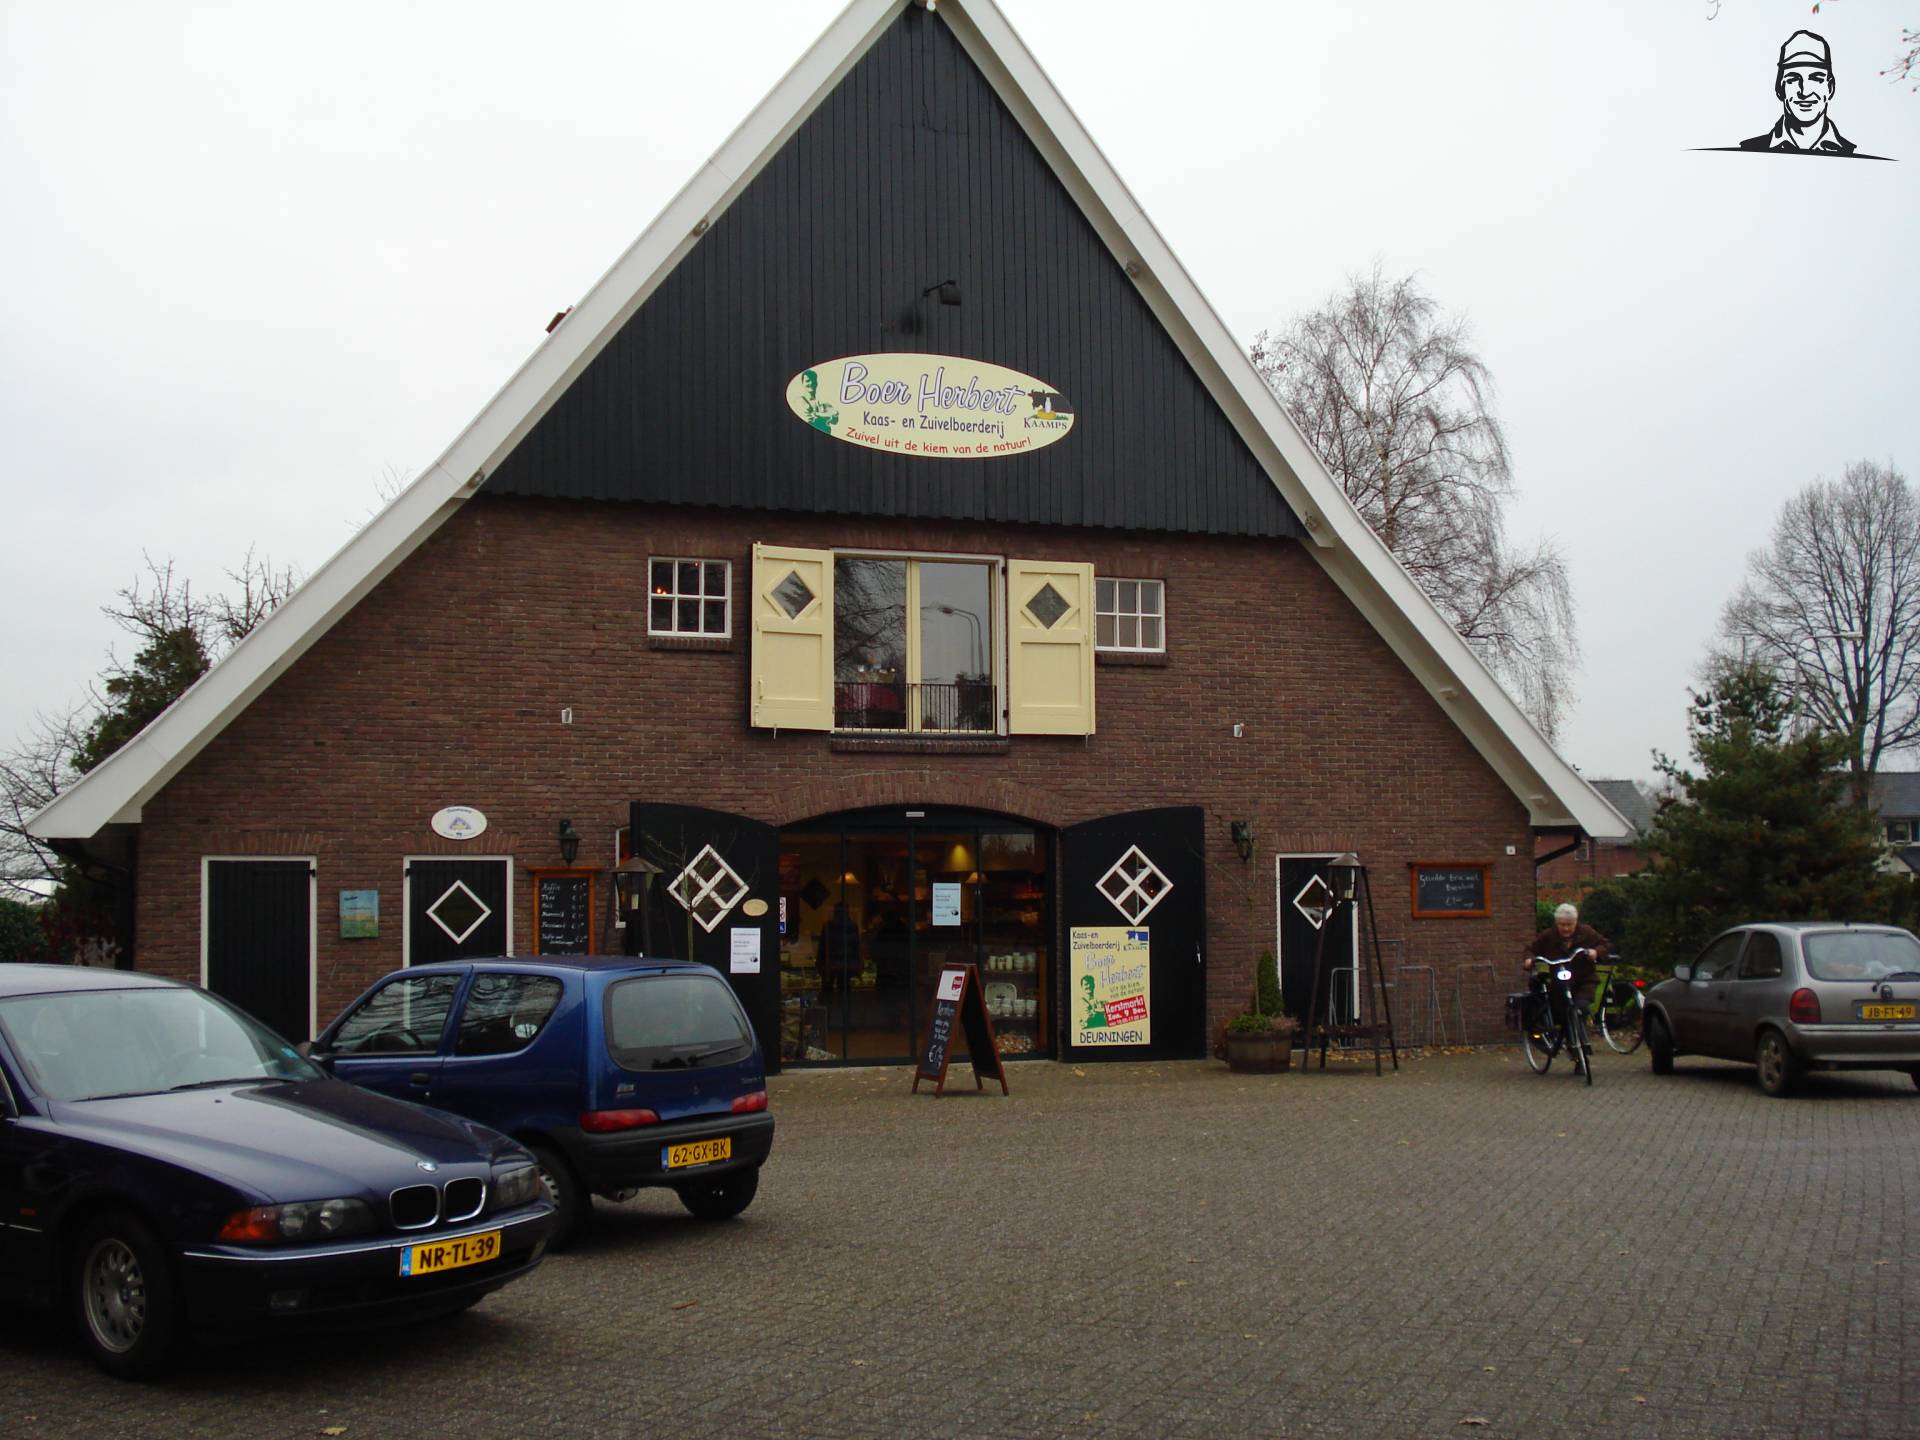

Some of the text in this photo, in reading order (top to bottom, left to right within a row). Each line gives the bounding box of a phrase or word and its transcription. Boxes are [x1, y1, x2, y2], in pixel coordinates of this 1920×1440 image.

[840, 361, 1025, 415] Boer Herbert
[863, 411, 1005, 439] Kaas- en Zuivelboerderij
[1024, 418, 1068, 430] KAAMPS
[846, 427, 1031, 454] Zuivel uit de kiem van de natuur!
[1073, 941, 1120, 952] Zuivelboerderij
[1105, 997, 1144, 1014] Kerstmarkt
[1079, 1031, 1143, 1044] DEURNINGEN
[672, 1142, 727, 1164] 62-GX-BK
[420, 1236, 495, 1269] NR-TL-39
